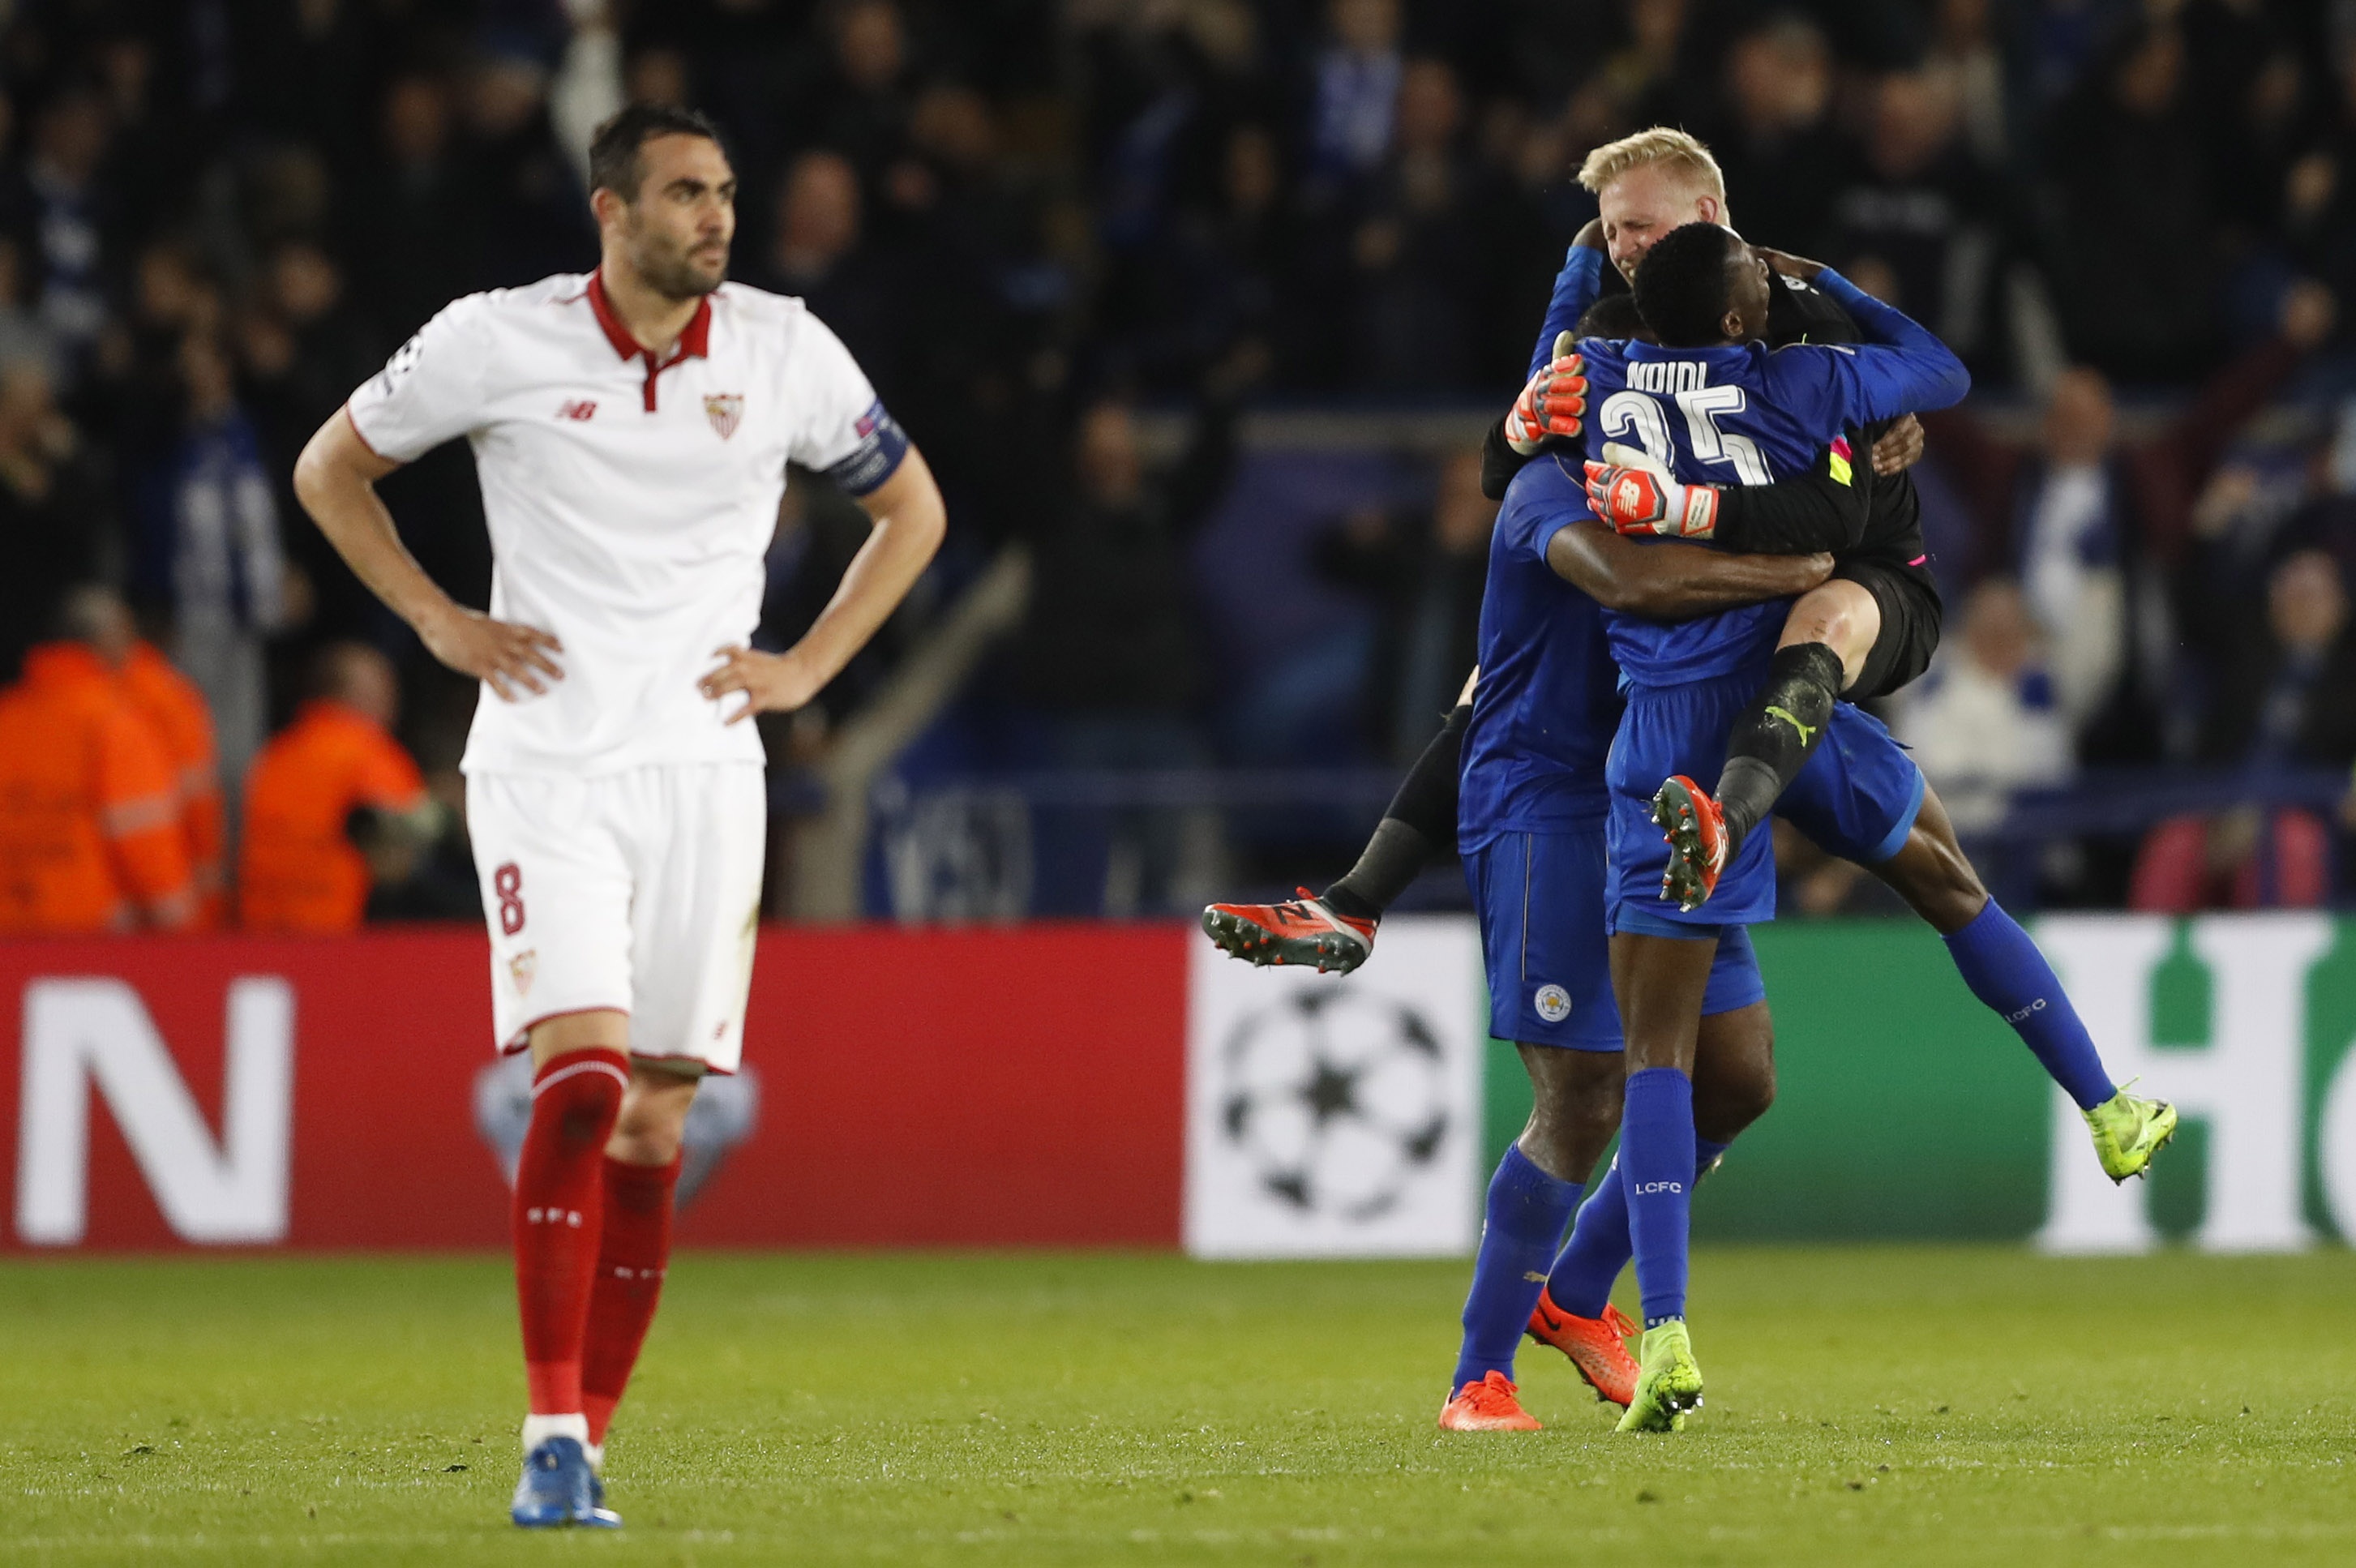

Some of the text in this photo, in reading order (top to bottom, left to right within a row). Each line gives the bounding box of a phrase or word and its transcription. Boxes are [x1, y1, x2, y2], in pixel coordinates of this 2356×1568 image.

[494, 861, 525, 936] 8
[2004, 998, 2047, 1023] LCFC
[15, 975, 297, 1246] N
[1636, 1181, 1682, 1195] LCFC
